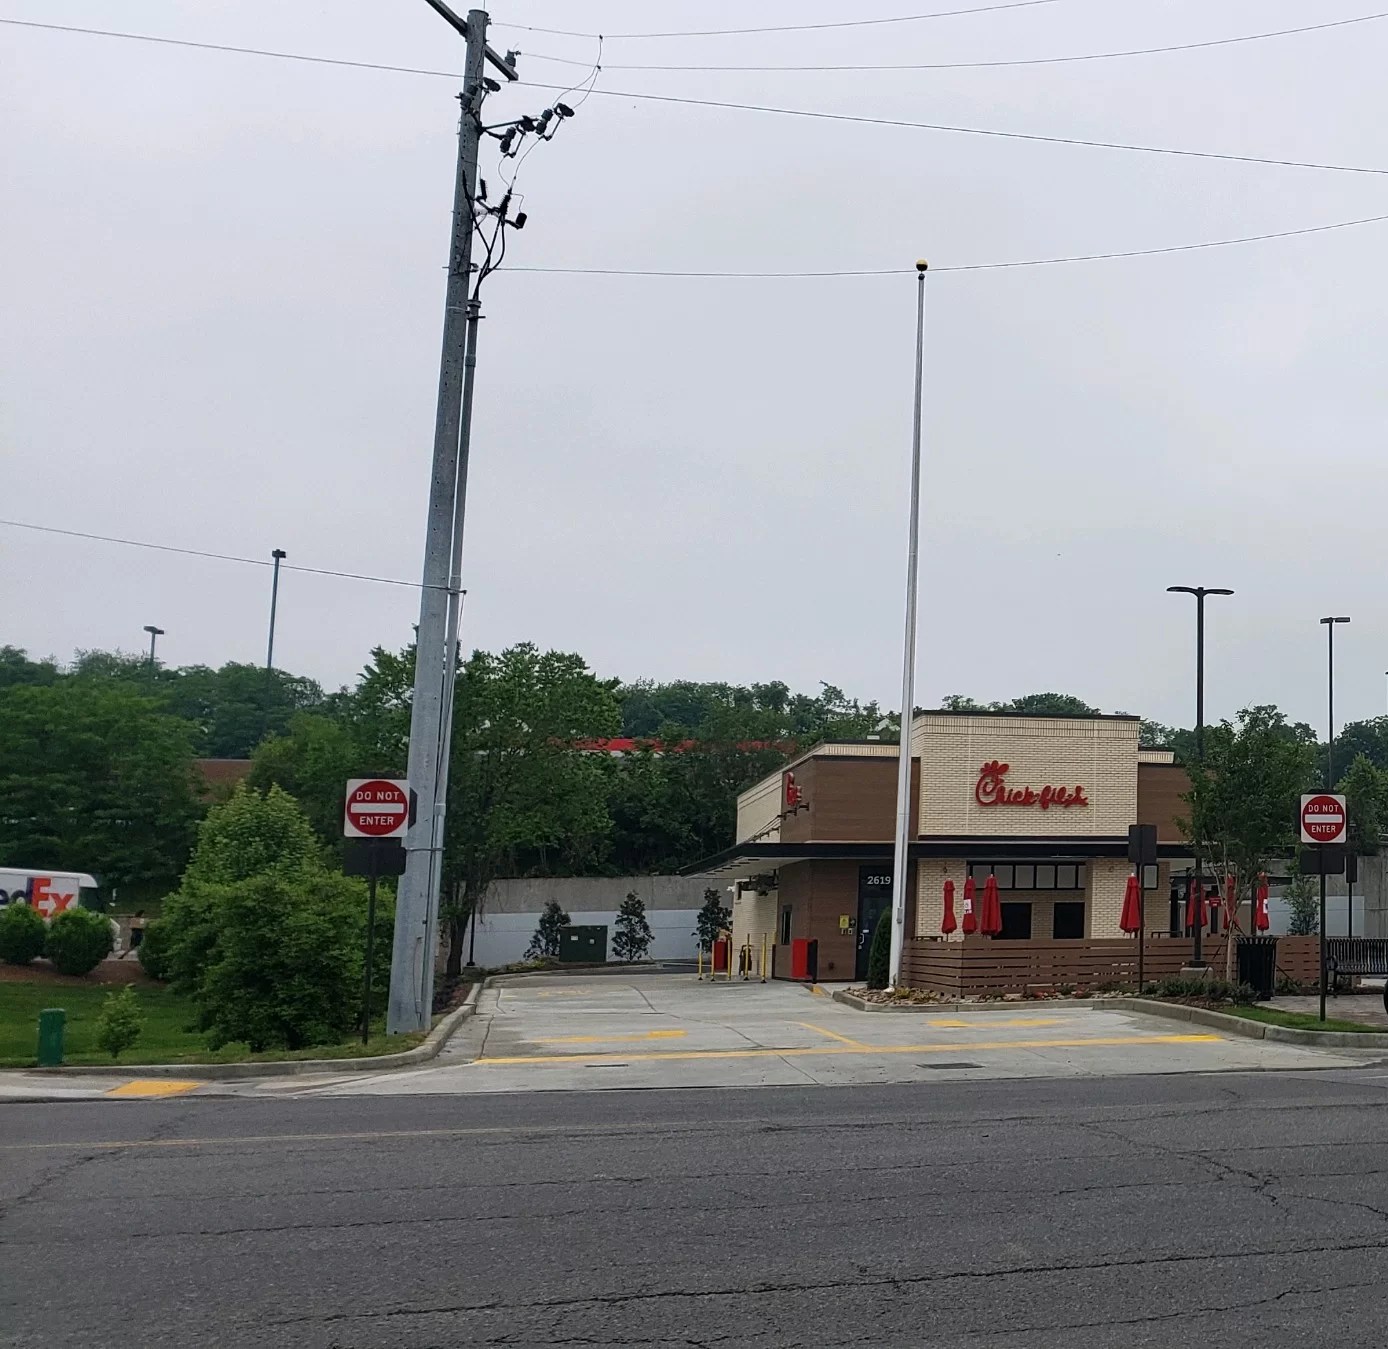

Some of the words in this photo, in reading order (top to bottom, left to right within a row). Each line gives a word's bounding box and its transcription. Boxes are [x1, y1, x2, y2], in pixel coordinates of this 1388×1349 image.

[356, 791, 372, 801] DO
[376, 791, 400, 801] NOT
[1308, 804, 1319, 813] DO
[1322, 804, 1339, 813] NOT
[359, 816, 395, 826] ENTER
[1311, 825, 1336, 833] ENTER
[866, 875, 892, 885] 2619
